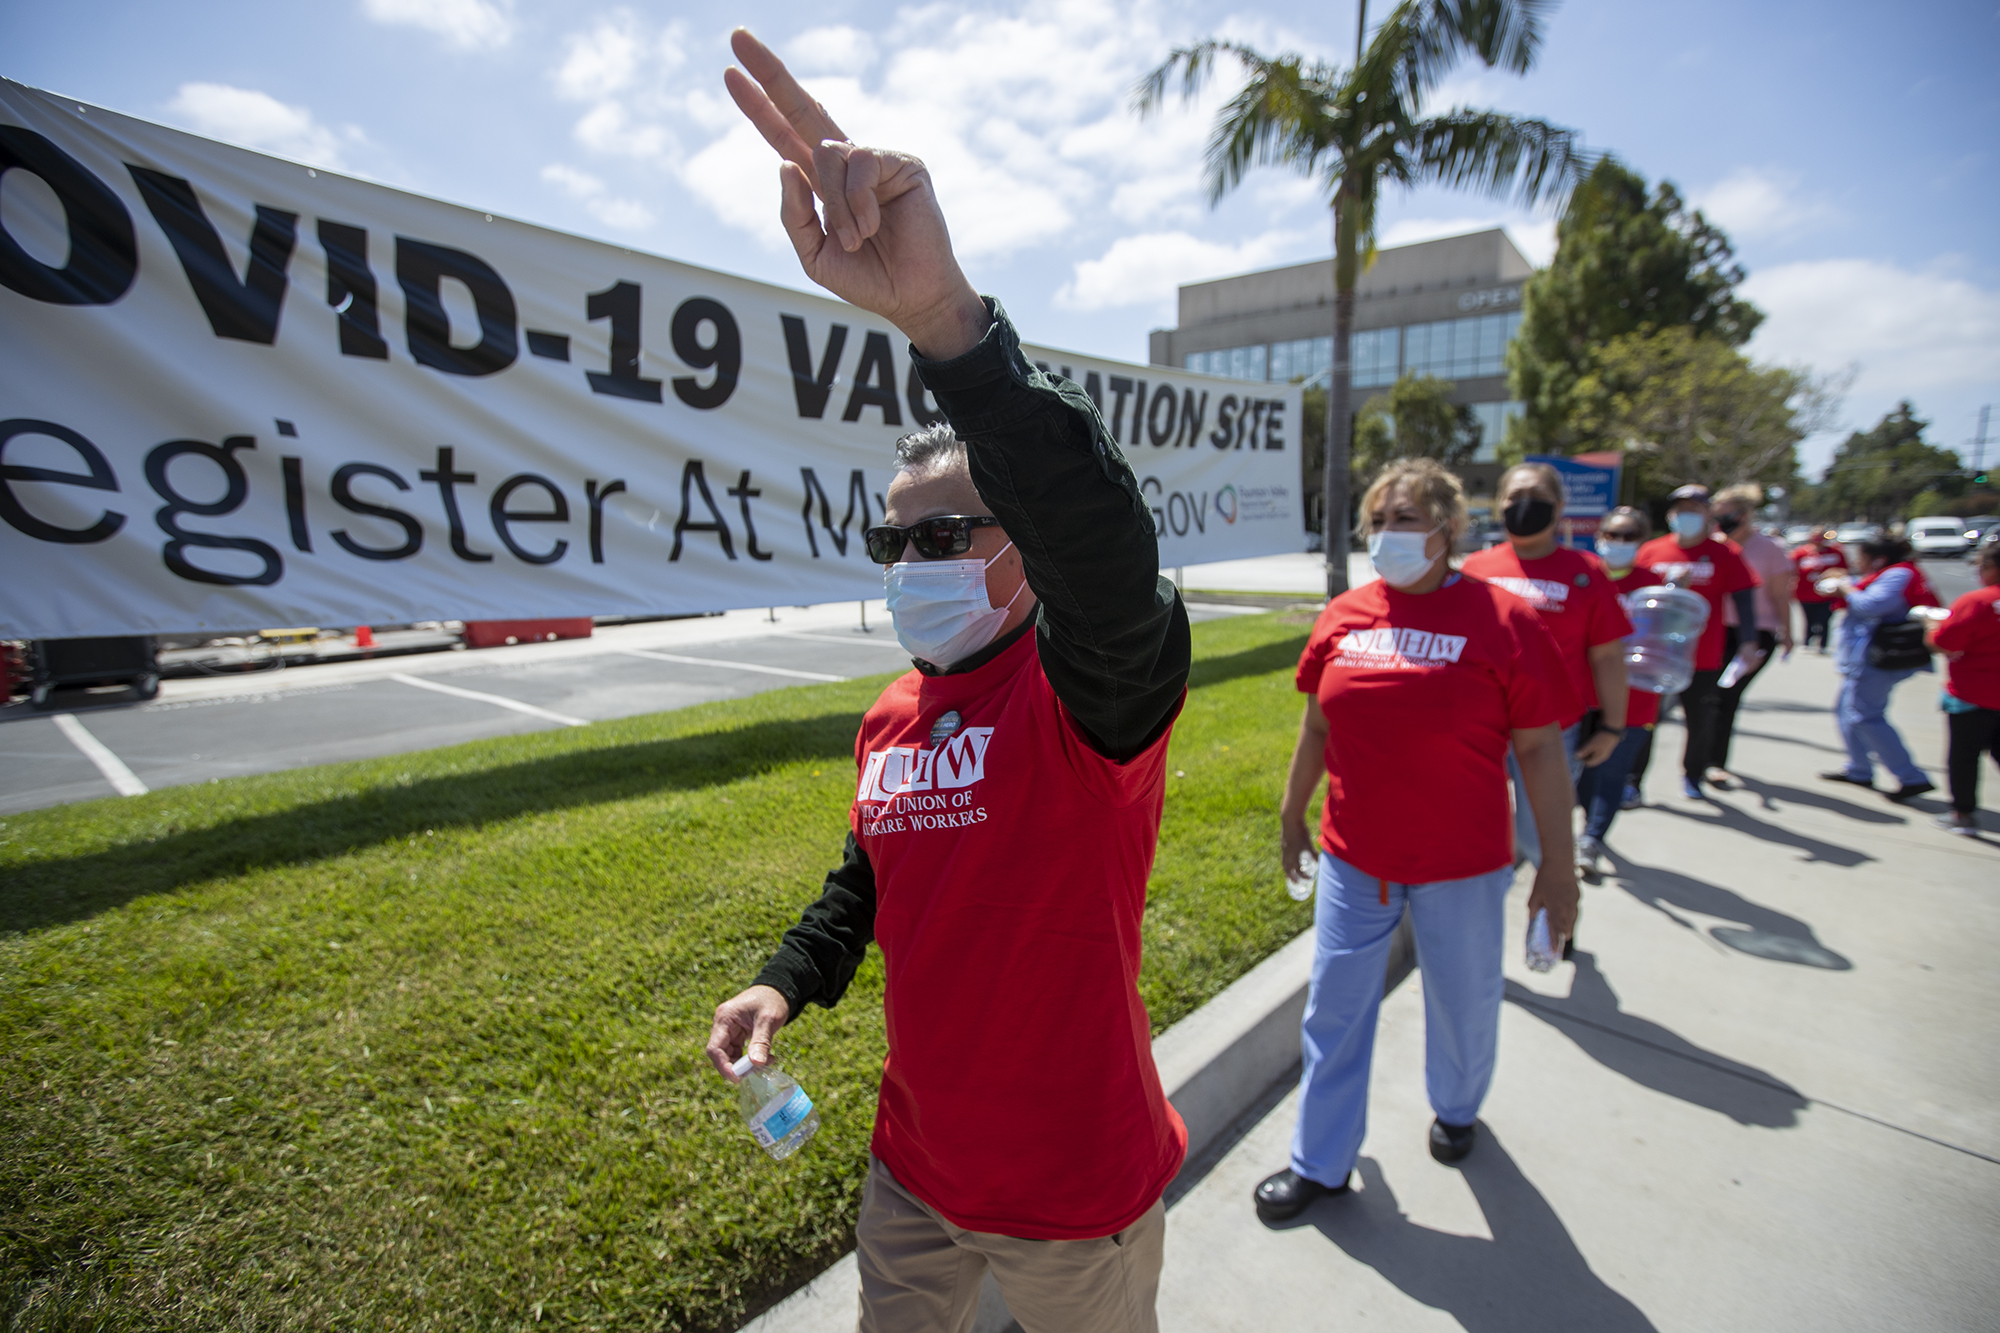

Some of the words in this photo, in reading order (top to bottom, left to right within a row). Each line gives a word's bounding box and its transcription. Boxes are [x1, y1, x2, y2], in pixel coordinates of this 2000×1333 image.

[1210, 393, 1286, 450] SITE
[668, 458, 774, 562] At
[896, 794, 947, 815] UNION
[952, 790, 973, 808] OF
[909, 806, 988, 832] WORKERS
